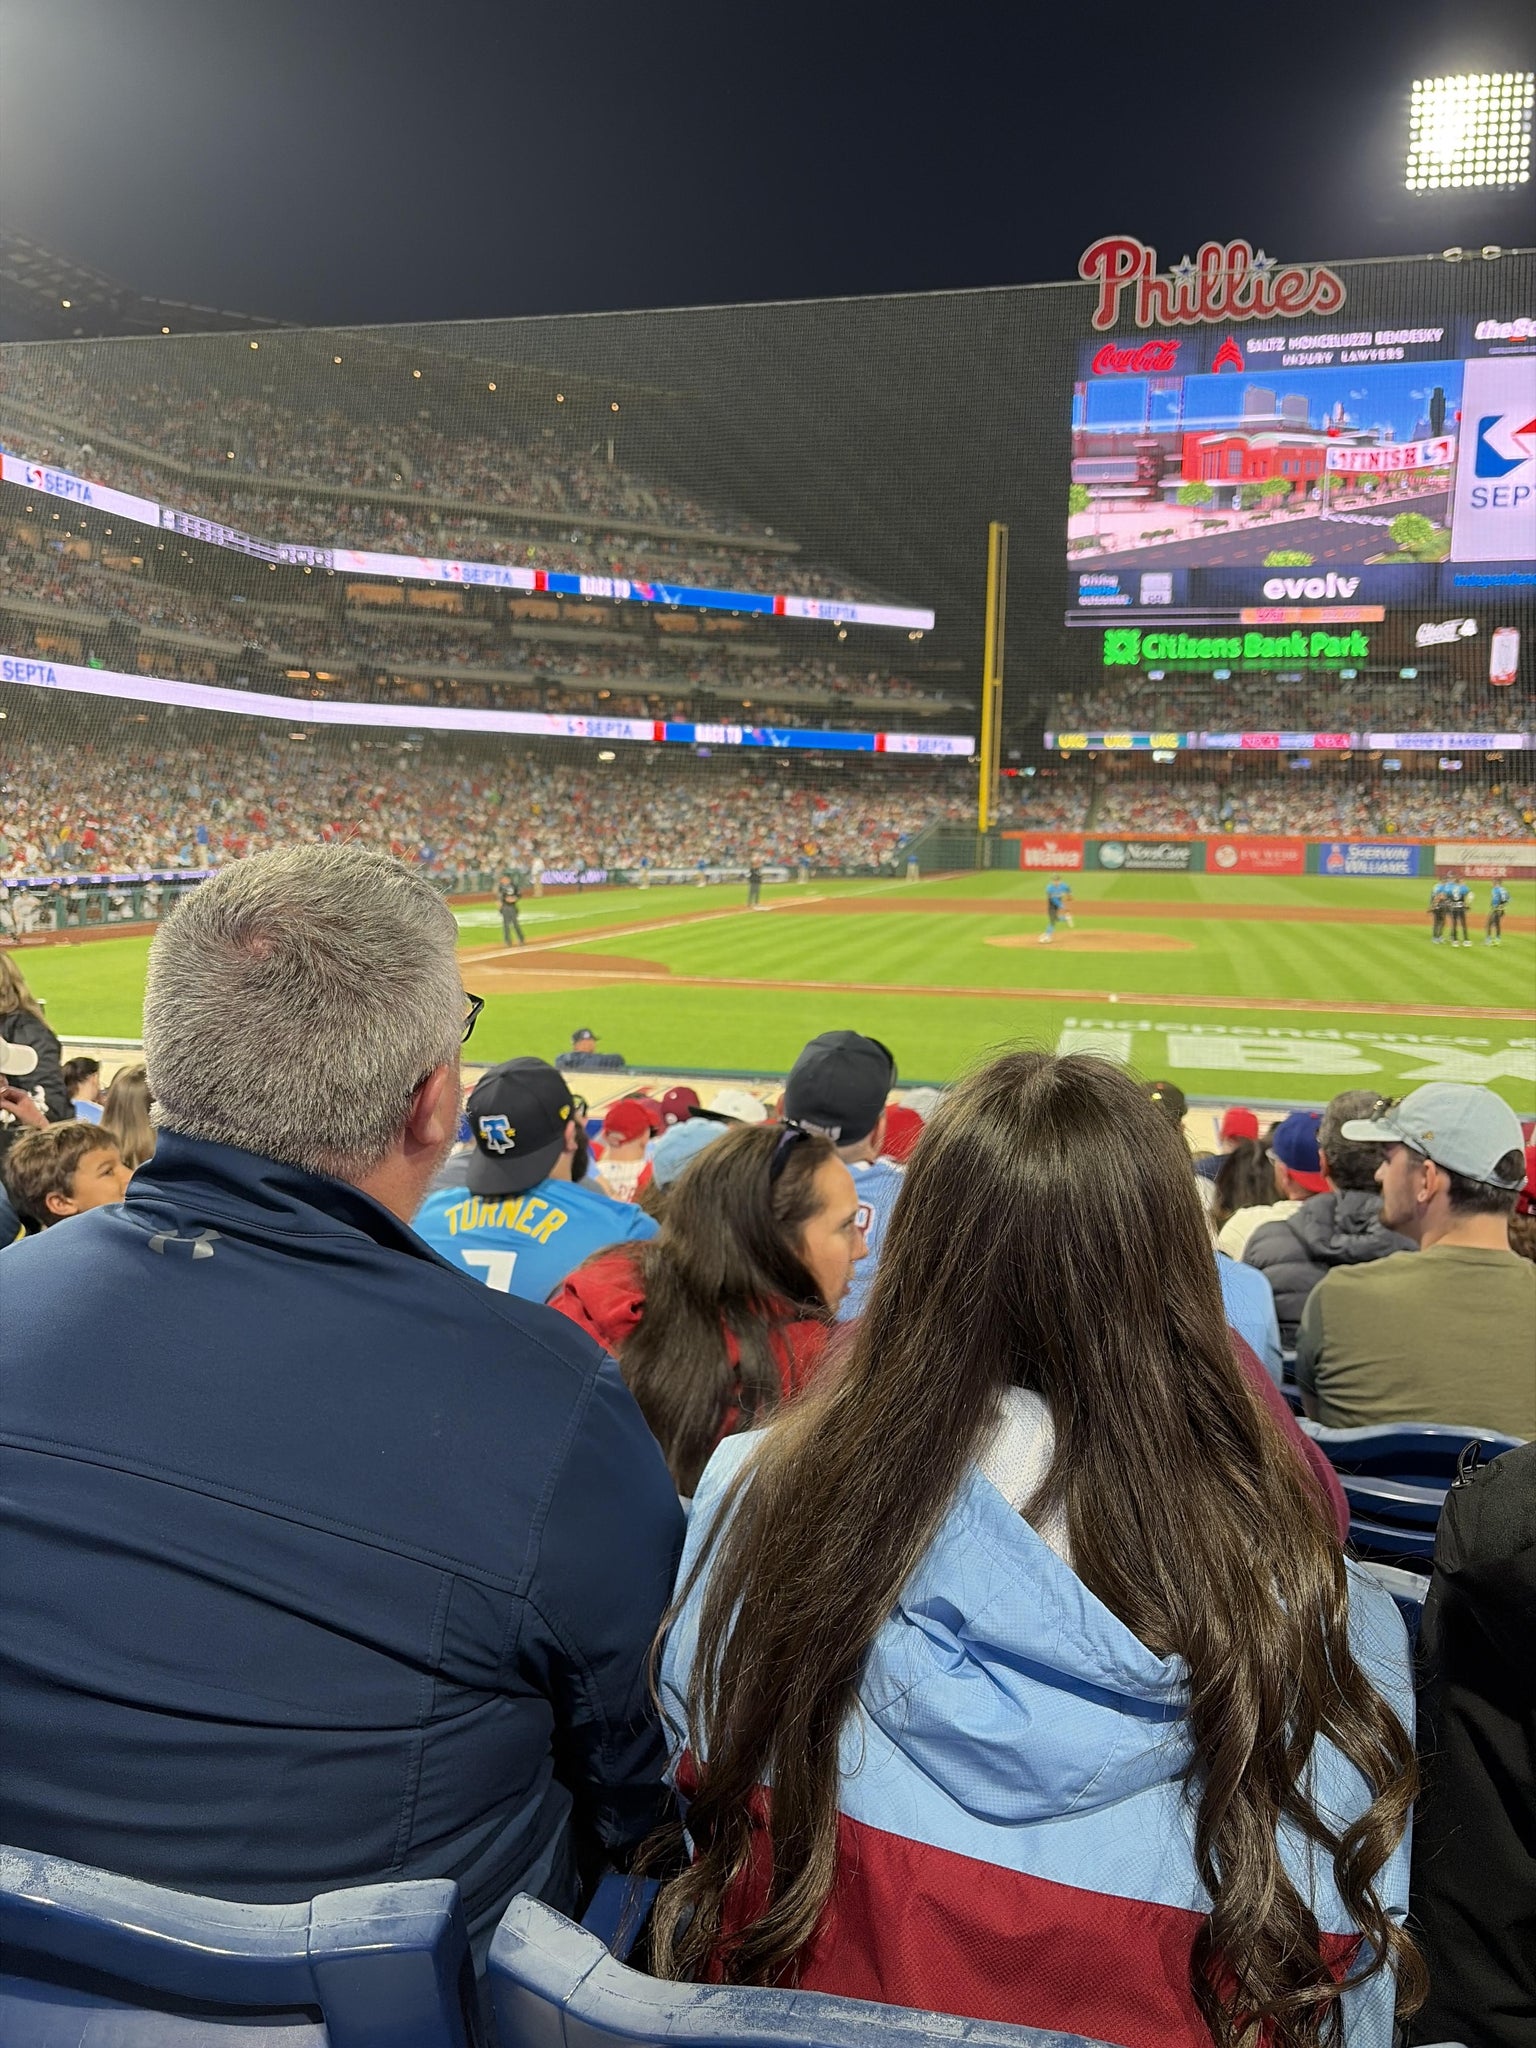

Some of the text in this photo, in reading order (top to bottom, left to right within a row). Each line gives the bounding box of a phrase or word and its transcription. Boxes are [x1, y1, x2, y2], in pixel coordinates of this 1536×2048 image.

[1078, 235, 1346, 330] Phillies
[1092, 339, 1181, 375] Coca-Cola
[1282, 348, 1404, 366] INJURY LAWYERS
[44, 472, 93, 502] SEPTA
[1471, 485, 1536, 509] SEP
[462, 568, 514, 586] SEPTA
[1263, 572, 1361, 599] evolv
[1142, 629, 1369, 659] Citizens Bank Park
[3, 660, 57, 686] SEPTA
[586, 721, 633, 737] SEPTA
[1024, 847, 1080, 867] Wawa
[1464, 866, 1507, 877] LAGER
[444, 1195, 568, 1245] TURNER
[461, 1248, 518, 1293] 7
